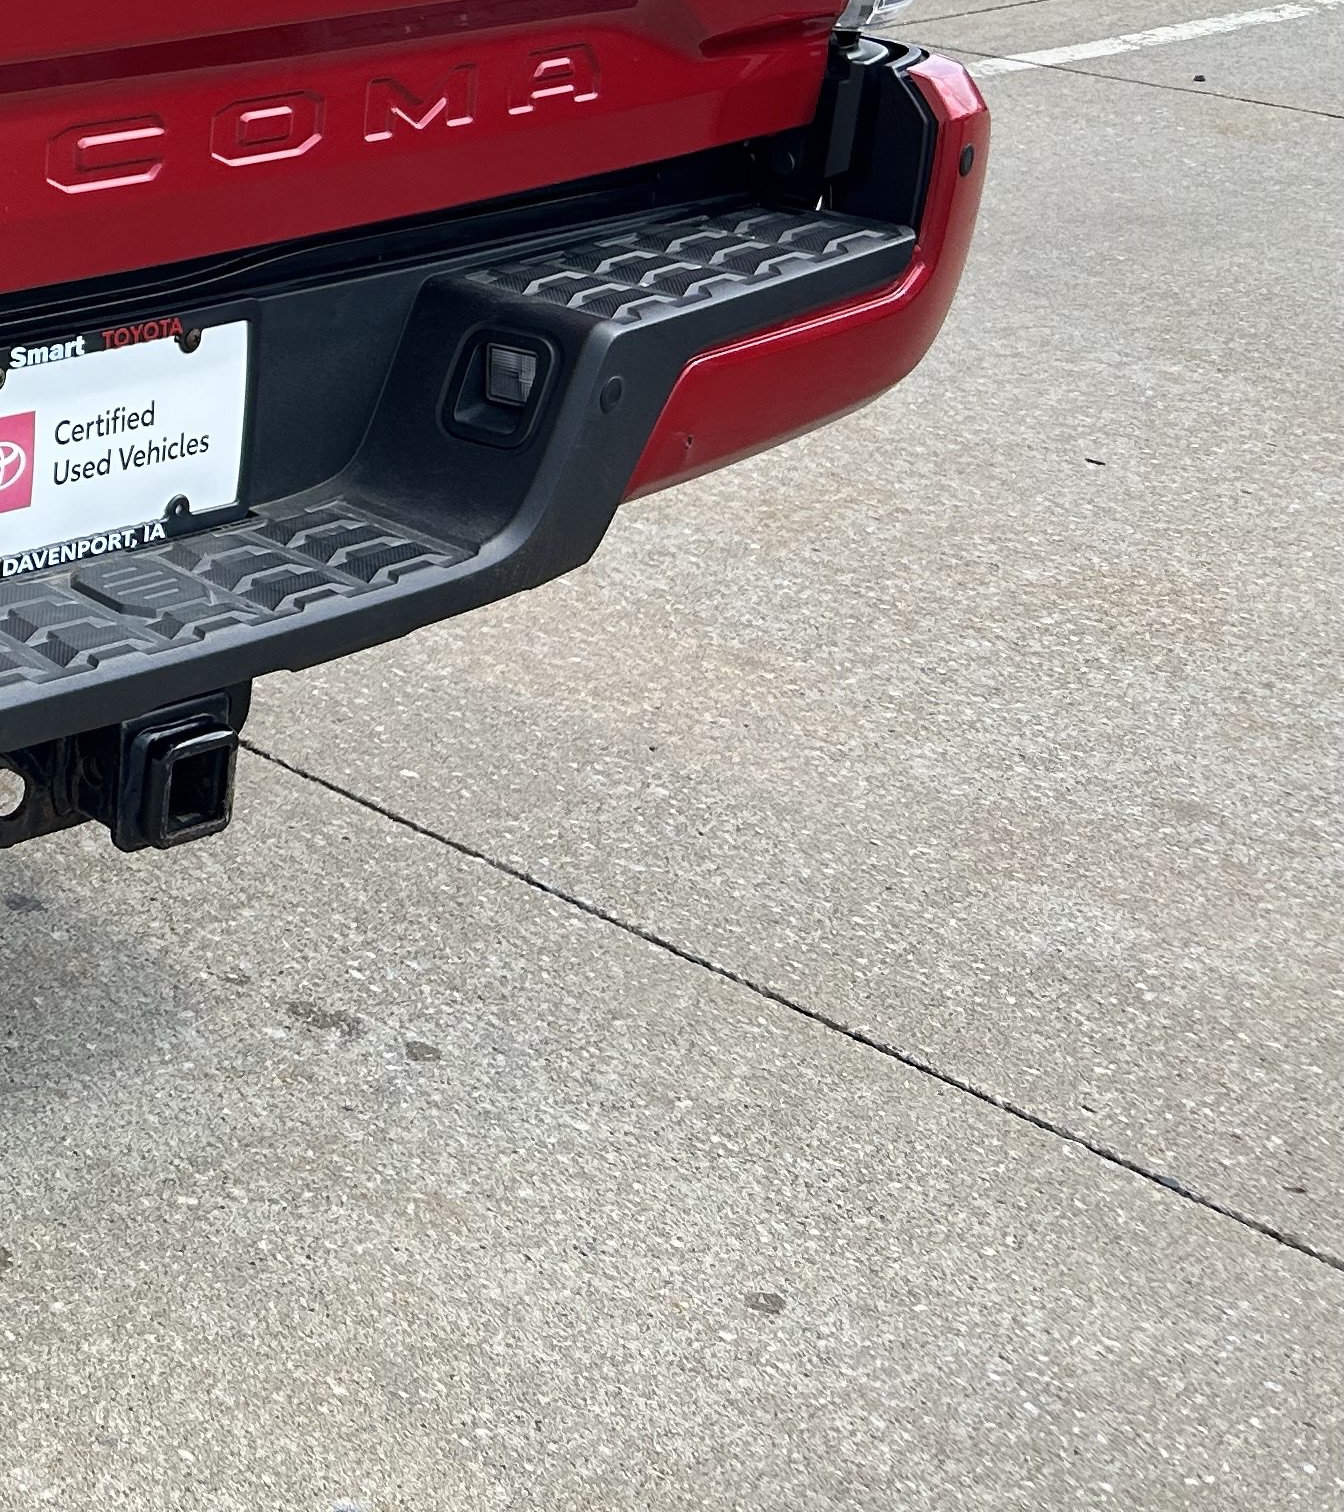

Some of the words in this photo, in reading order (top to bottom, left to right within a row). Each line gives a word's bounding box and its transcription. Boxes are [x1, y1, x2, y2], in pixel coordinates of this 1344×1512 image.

[9, 334, 86, 370] Smart
[101, 317, 184, 351] TOYOTA
[54, 399, 156, 446] Certified
[52, 448, 111, 486] Used
[118, 433, 210, 473] Vehicles
[2, 533, 138, 578] DAVENPORT,
[143, 521, 166, 542] IA
